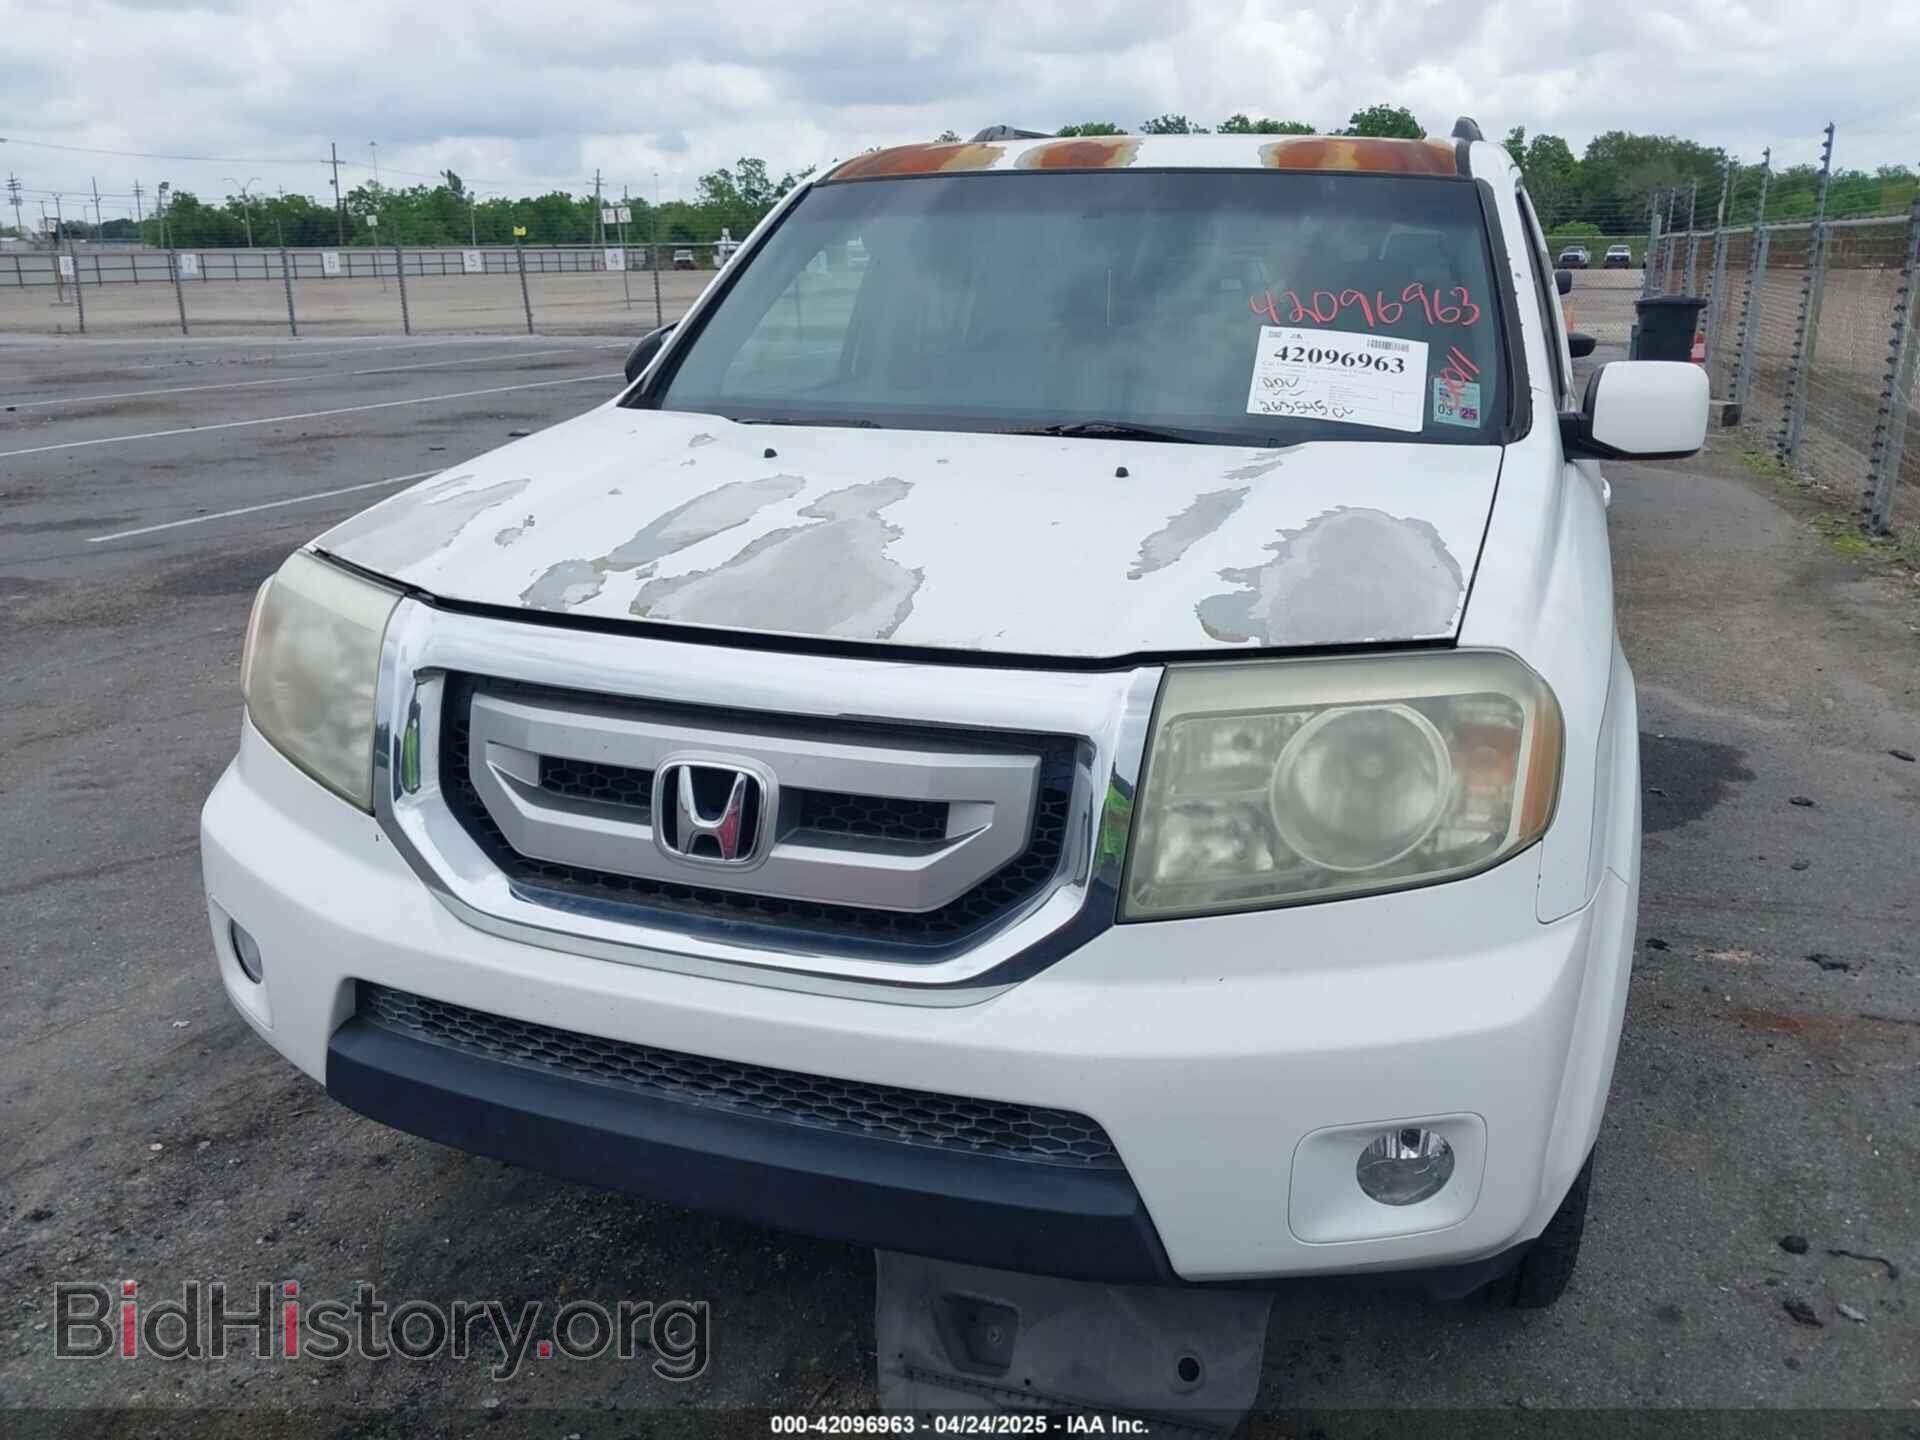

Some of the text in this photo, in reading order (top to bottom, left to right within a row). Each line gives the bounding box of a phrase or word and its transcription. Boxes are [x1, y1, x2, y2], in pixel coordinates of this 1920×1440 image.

[1250, 283, 1481, 327] 42096963
[1274, 345, 1405, 374] 42096963
[1460, 407, 1478, 420] 25
